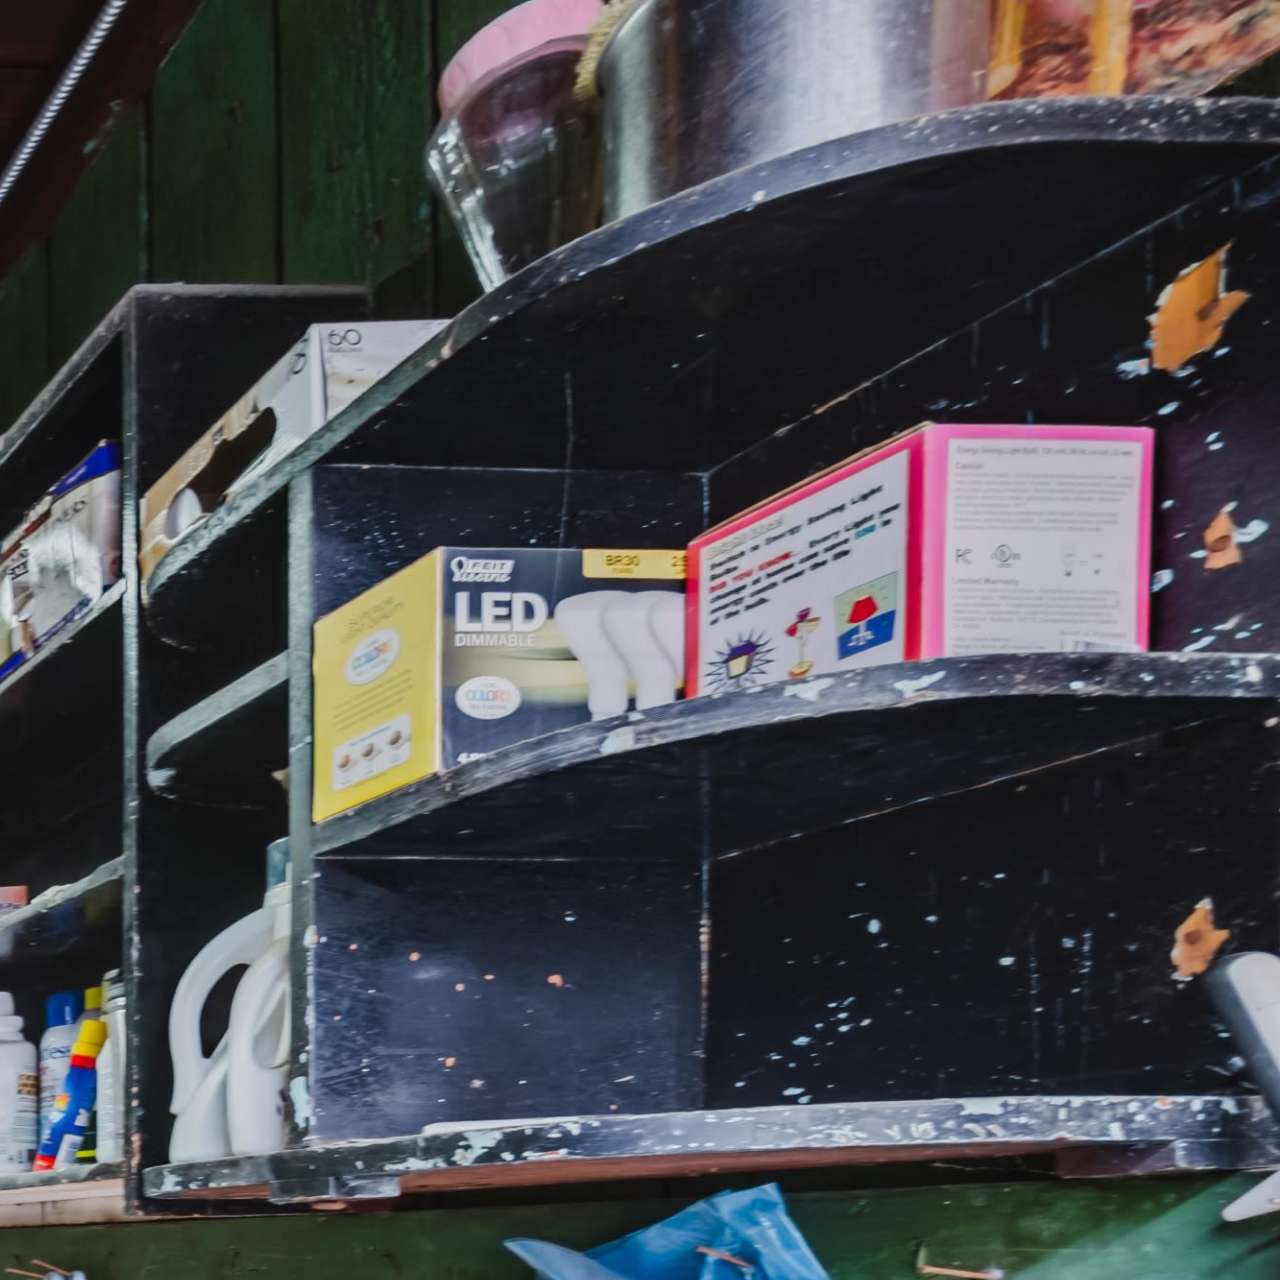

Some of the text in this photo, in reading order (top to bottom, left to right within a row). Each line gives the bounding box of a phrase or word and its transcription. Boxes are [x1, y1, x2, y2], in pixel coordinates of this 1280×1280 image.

[470, 560, 508, 571] FEIT
[455, 591, 549, 633] LED
[454, 633, 537, 648] DIMMABLE
